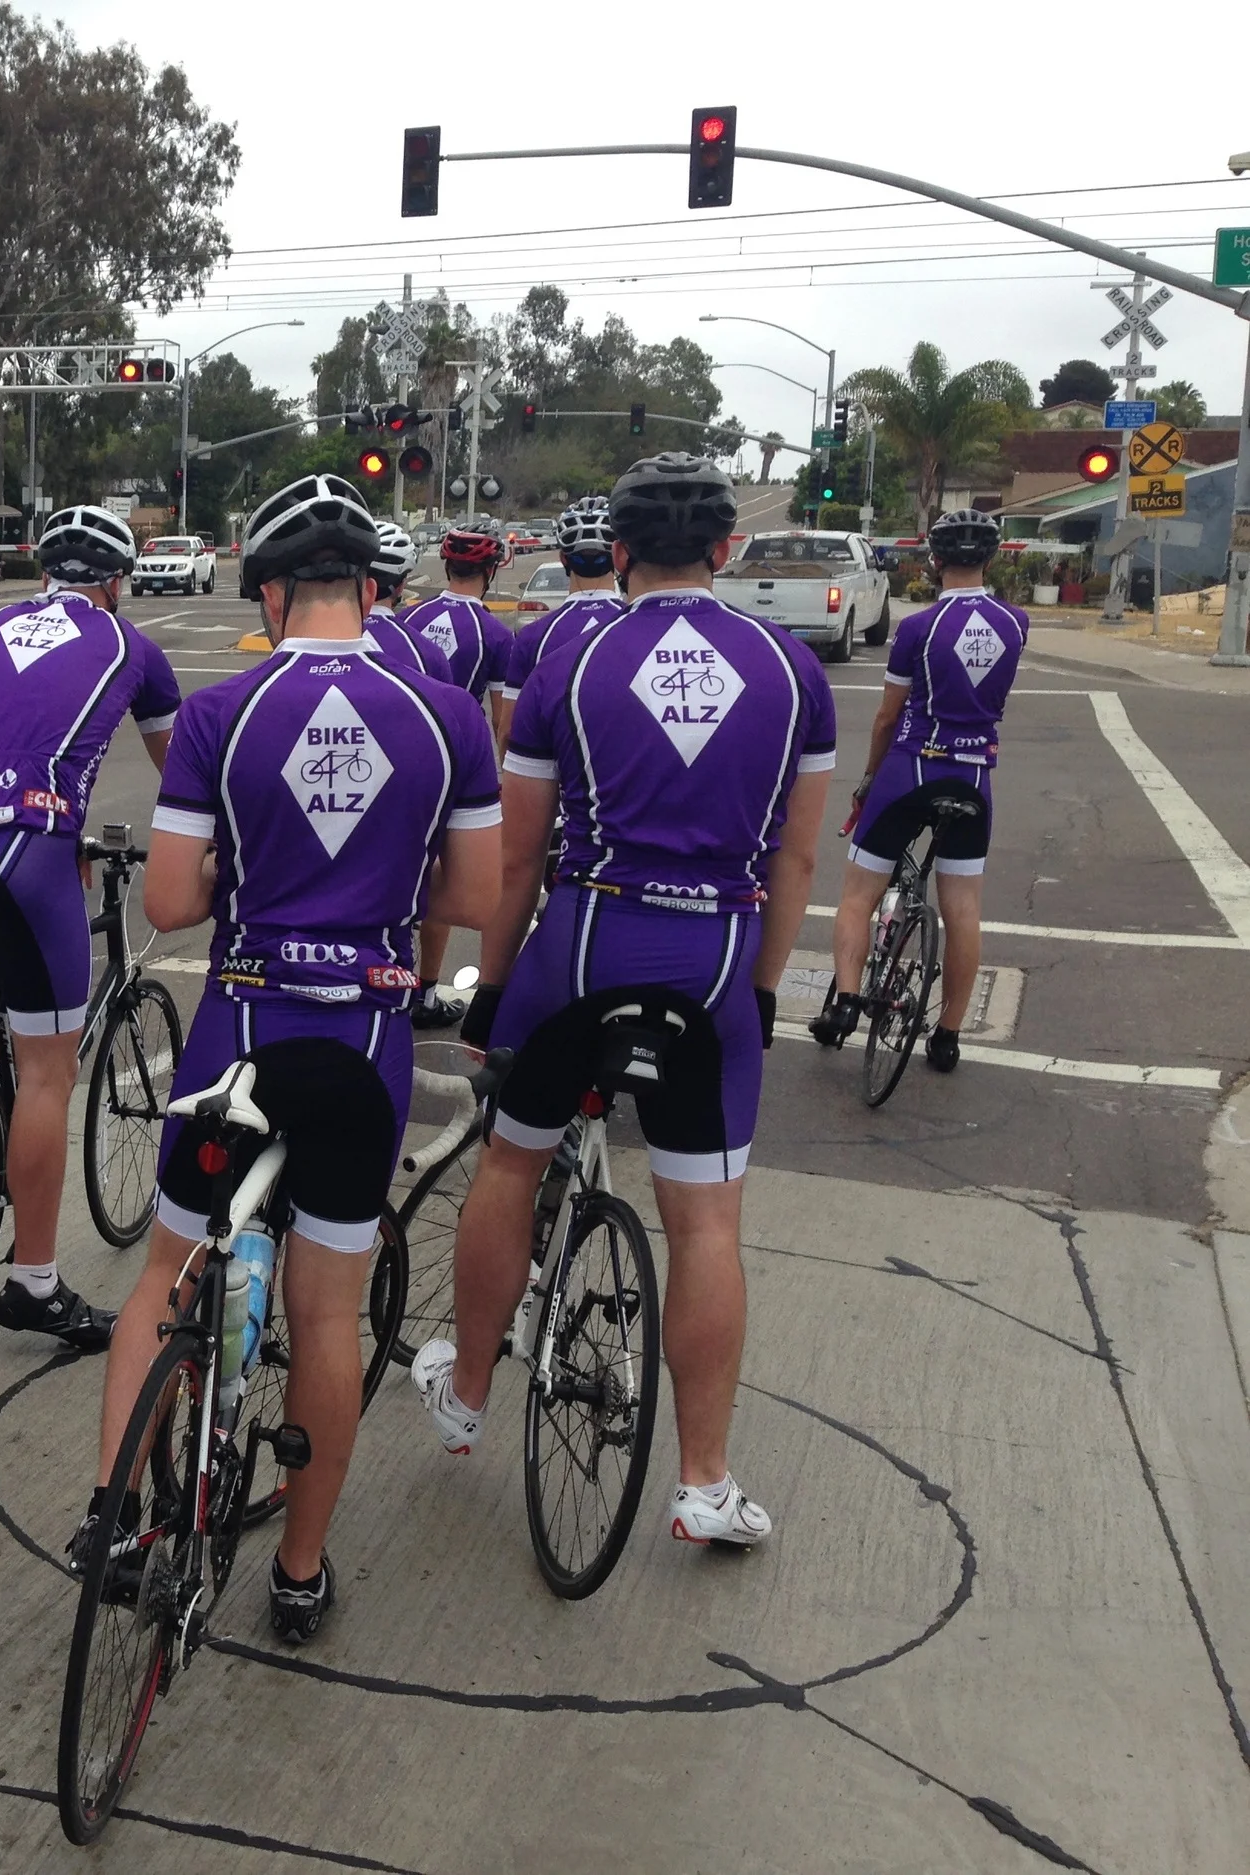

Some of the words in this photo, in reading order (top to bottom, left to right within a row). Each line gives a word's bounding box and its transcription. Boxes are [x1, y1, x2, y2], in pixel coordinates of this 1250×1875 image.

[1104, 289, 1170, 346] CROSSING
[374, 301, 425, 354] CROSSING
[1130, 354, 1138, 365] 2
[1112, 367, 1155, 376] TRACKS
[1133, 443, 1144, 457] R
[1168, 440, 1180, 453] R
[1152, 482, 1161, 495] 2
[1135, 495, 1180, 508] TRACKS
[26, 614, 70, 625] BIKE
[428, 624, 452, 636] BIKE
[965, 628, 993, 637] BIKE
[7, 636, 55, 650] ALZ
[655, 649, 716, 664] BIKE
[965, 658, 993, 668] ALZ
[660, 705, 720, 724] ALZ
[307, 726, 365, 746] BIKE
[306, 792, 365, 814] ALZ
